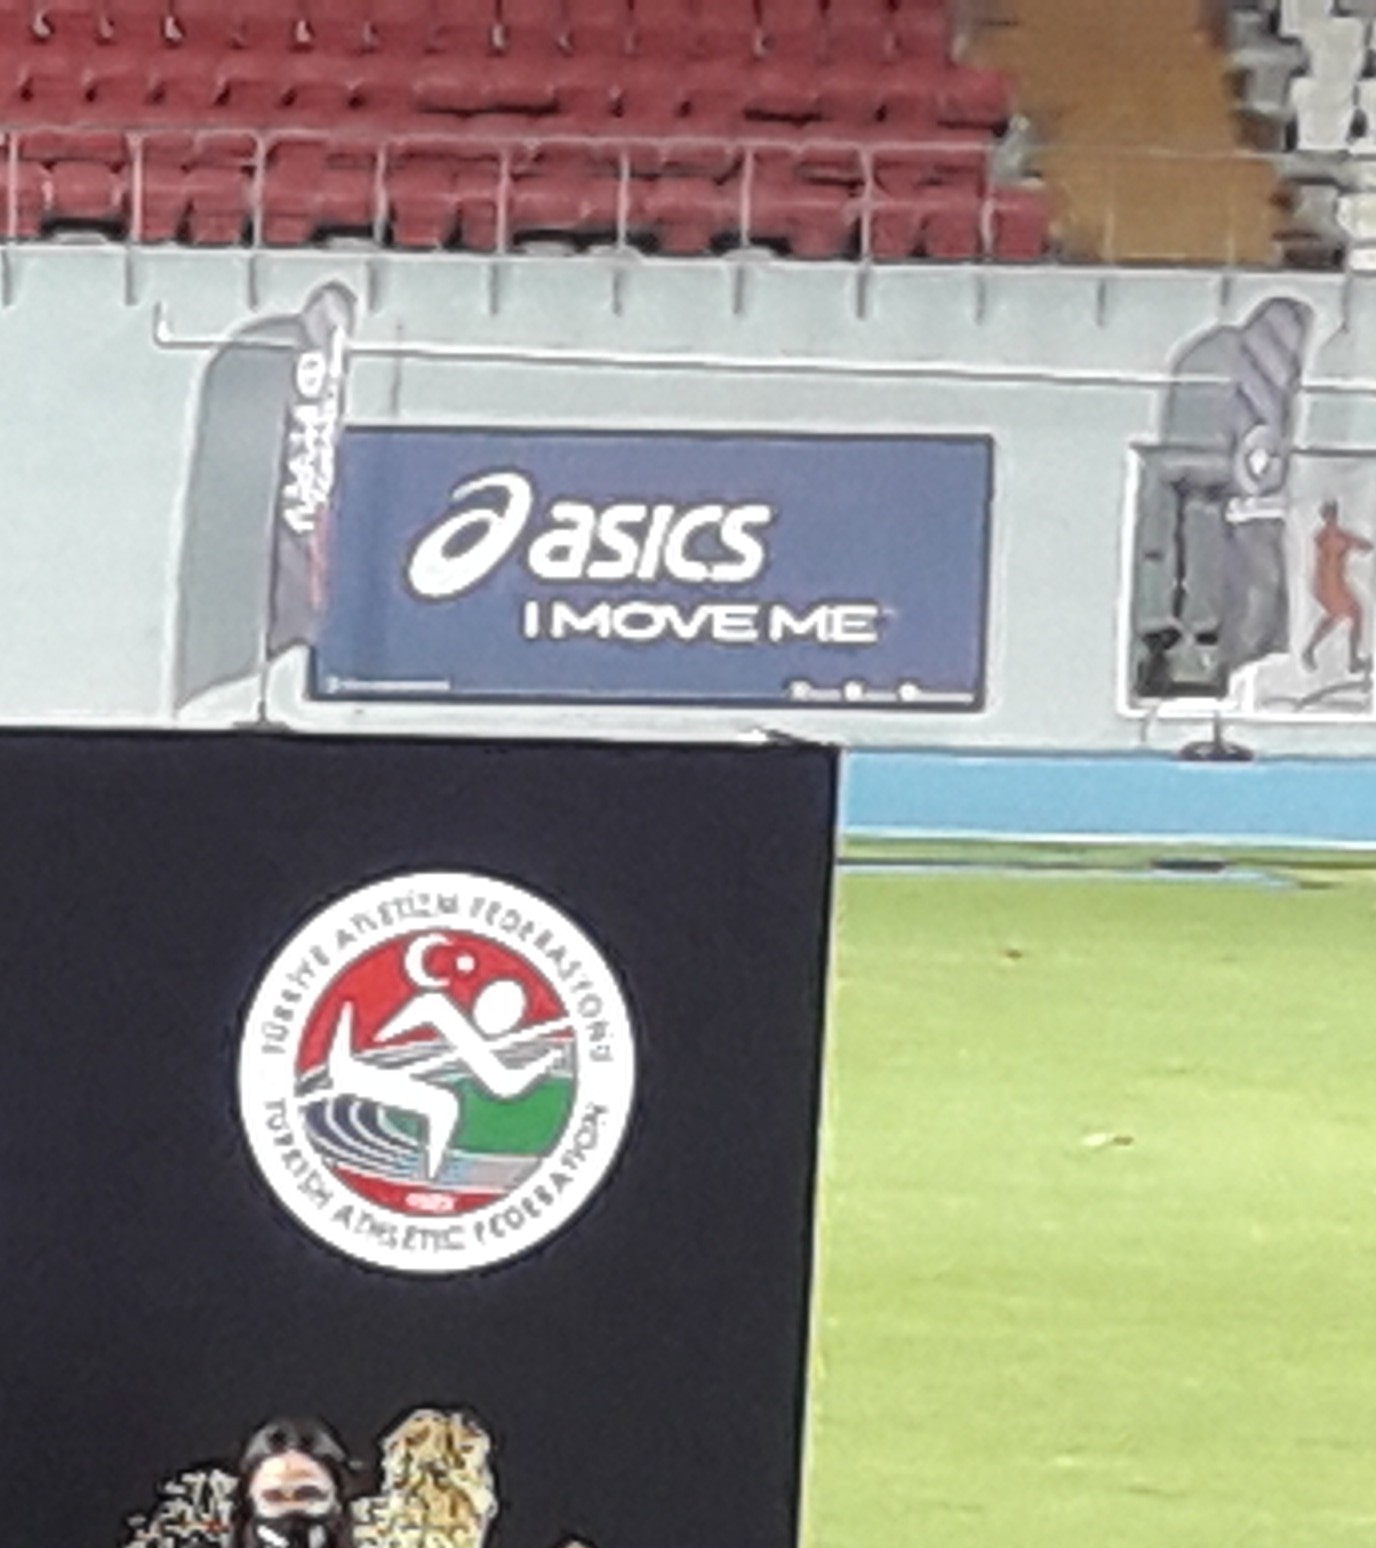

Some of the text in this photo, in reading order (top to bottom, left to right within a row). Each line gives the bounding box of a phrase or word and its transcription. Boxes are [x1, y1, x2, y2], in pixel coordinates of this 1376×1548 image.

[524, 600, 880, 643] I MOVE ME
